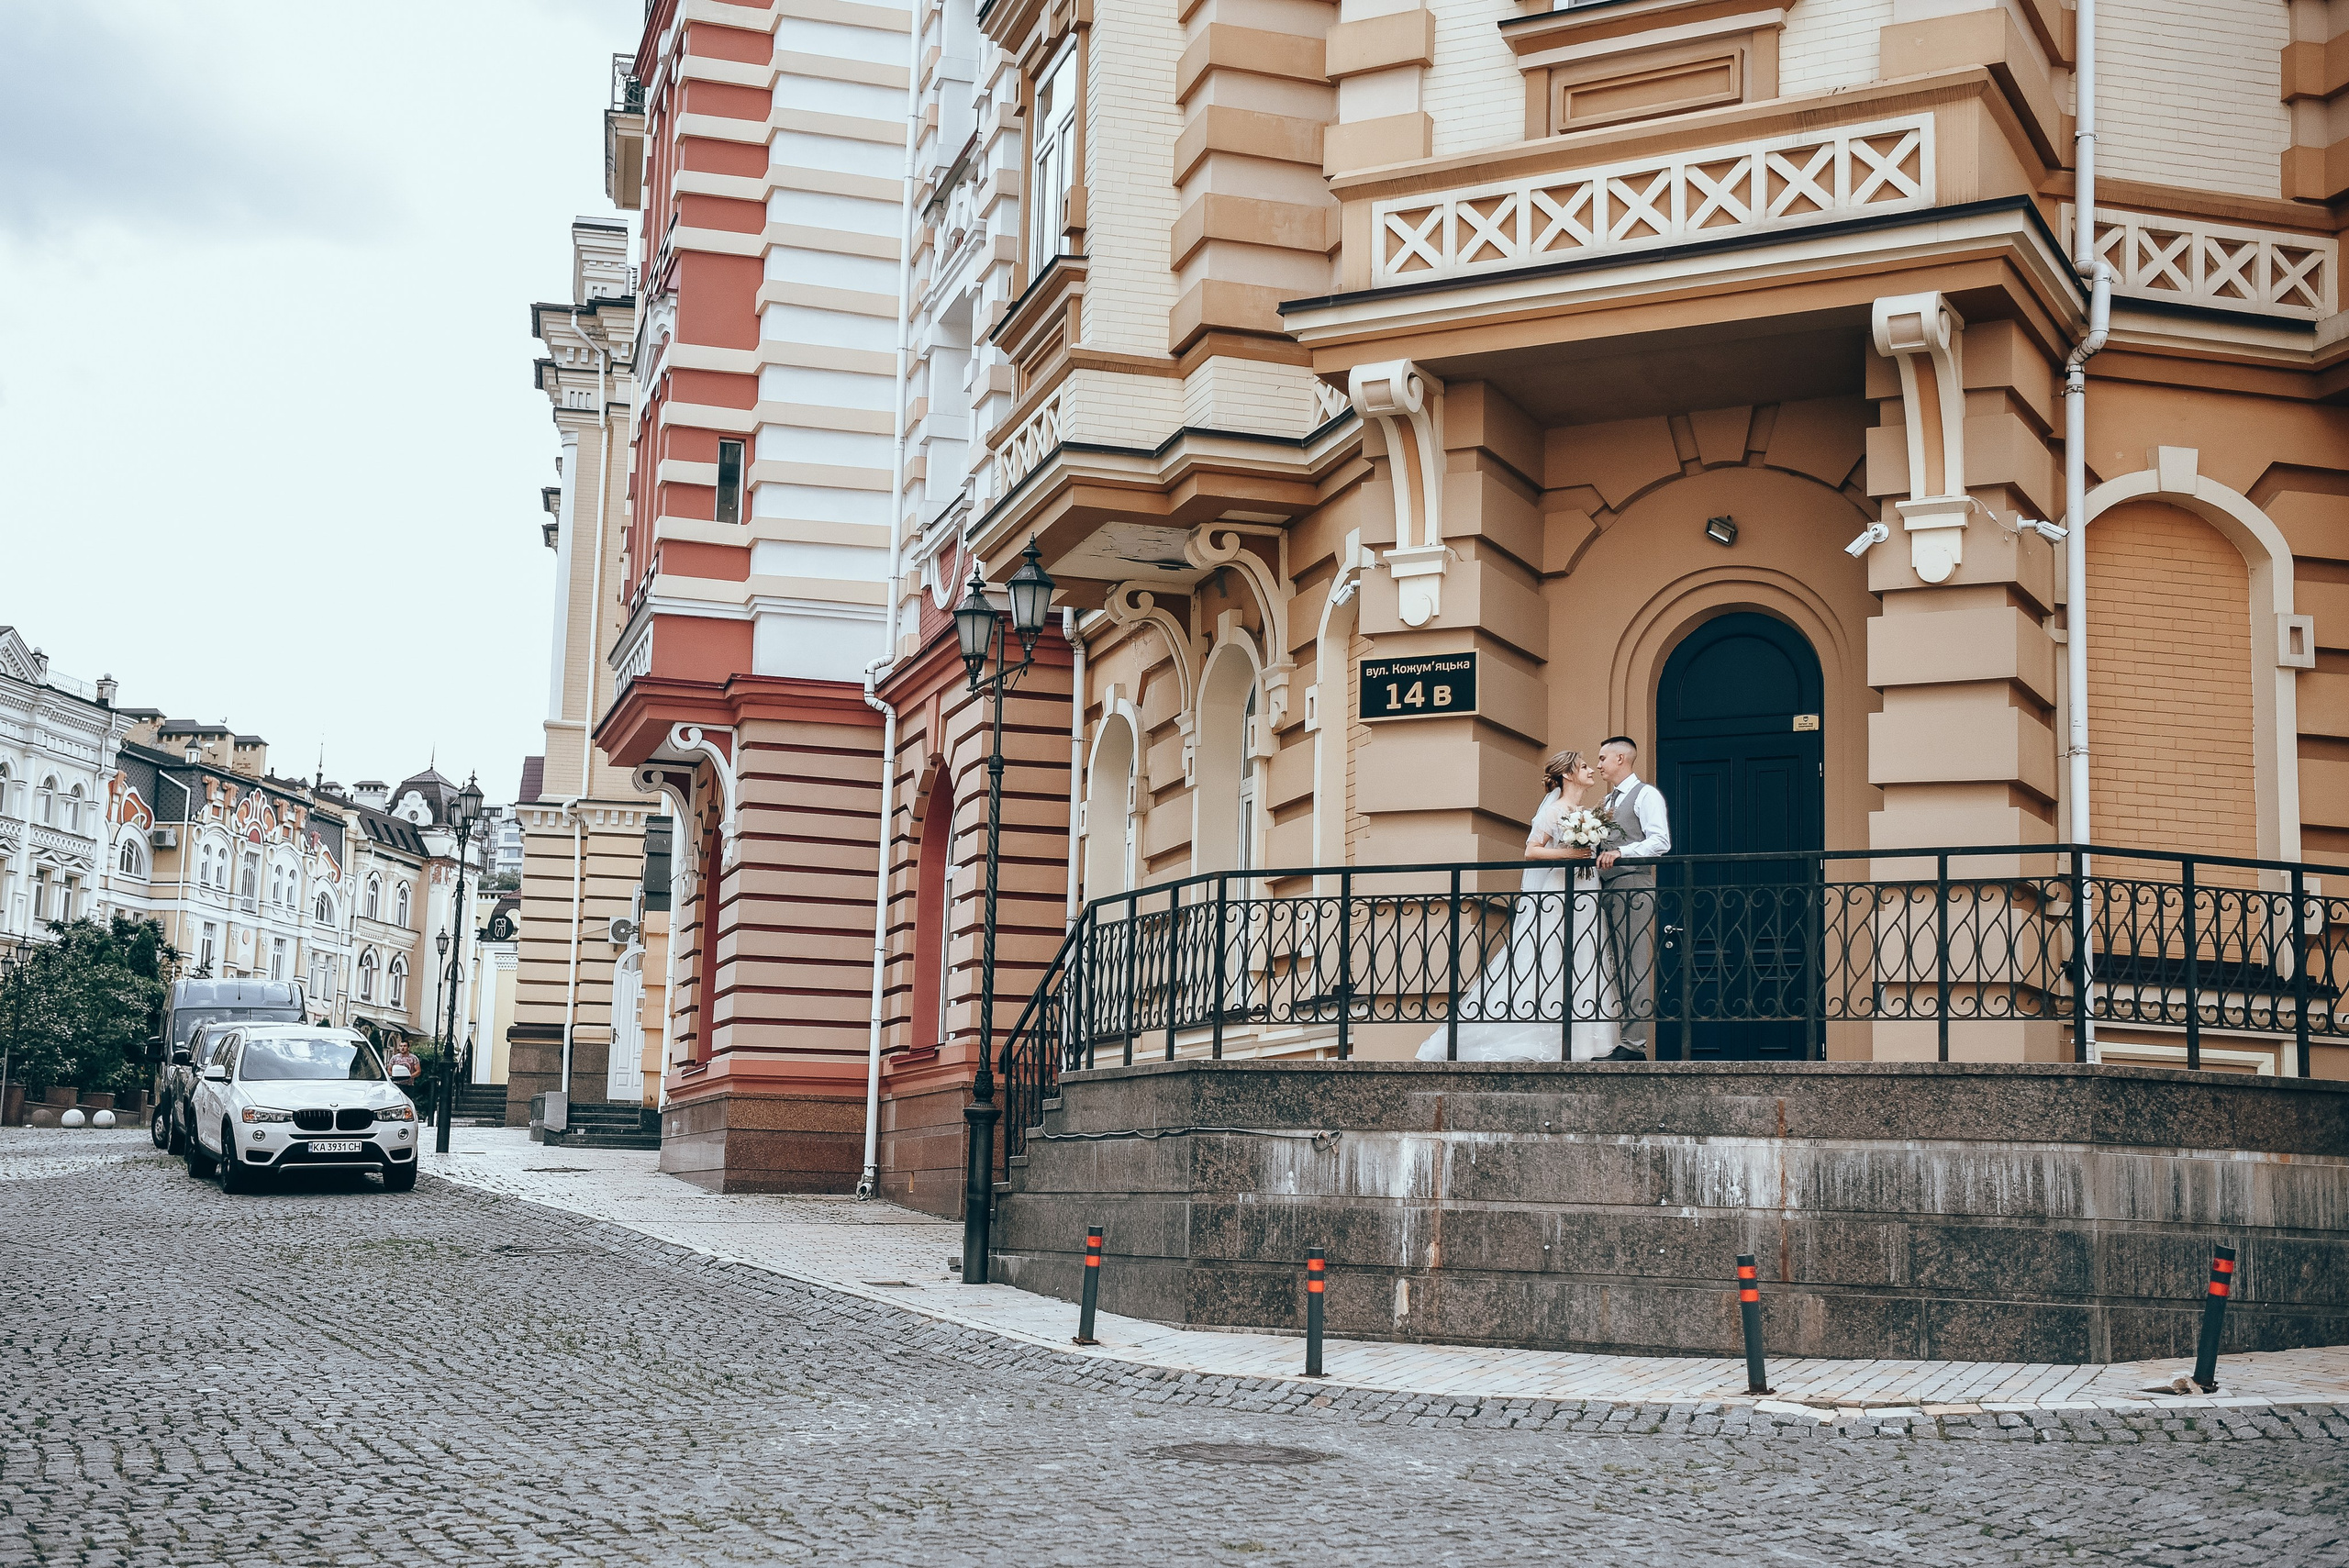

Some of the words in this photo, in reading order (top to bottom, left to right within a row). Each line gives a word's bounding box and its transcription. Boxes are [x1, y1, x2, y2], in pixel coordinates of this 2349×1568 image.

[1365, 667, 1389, 679] вул.
[1386, 681, 1425, 709] 14
[313, 1143, 326, 1151] KA
[328, 1143, 347, 1151] 3931
